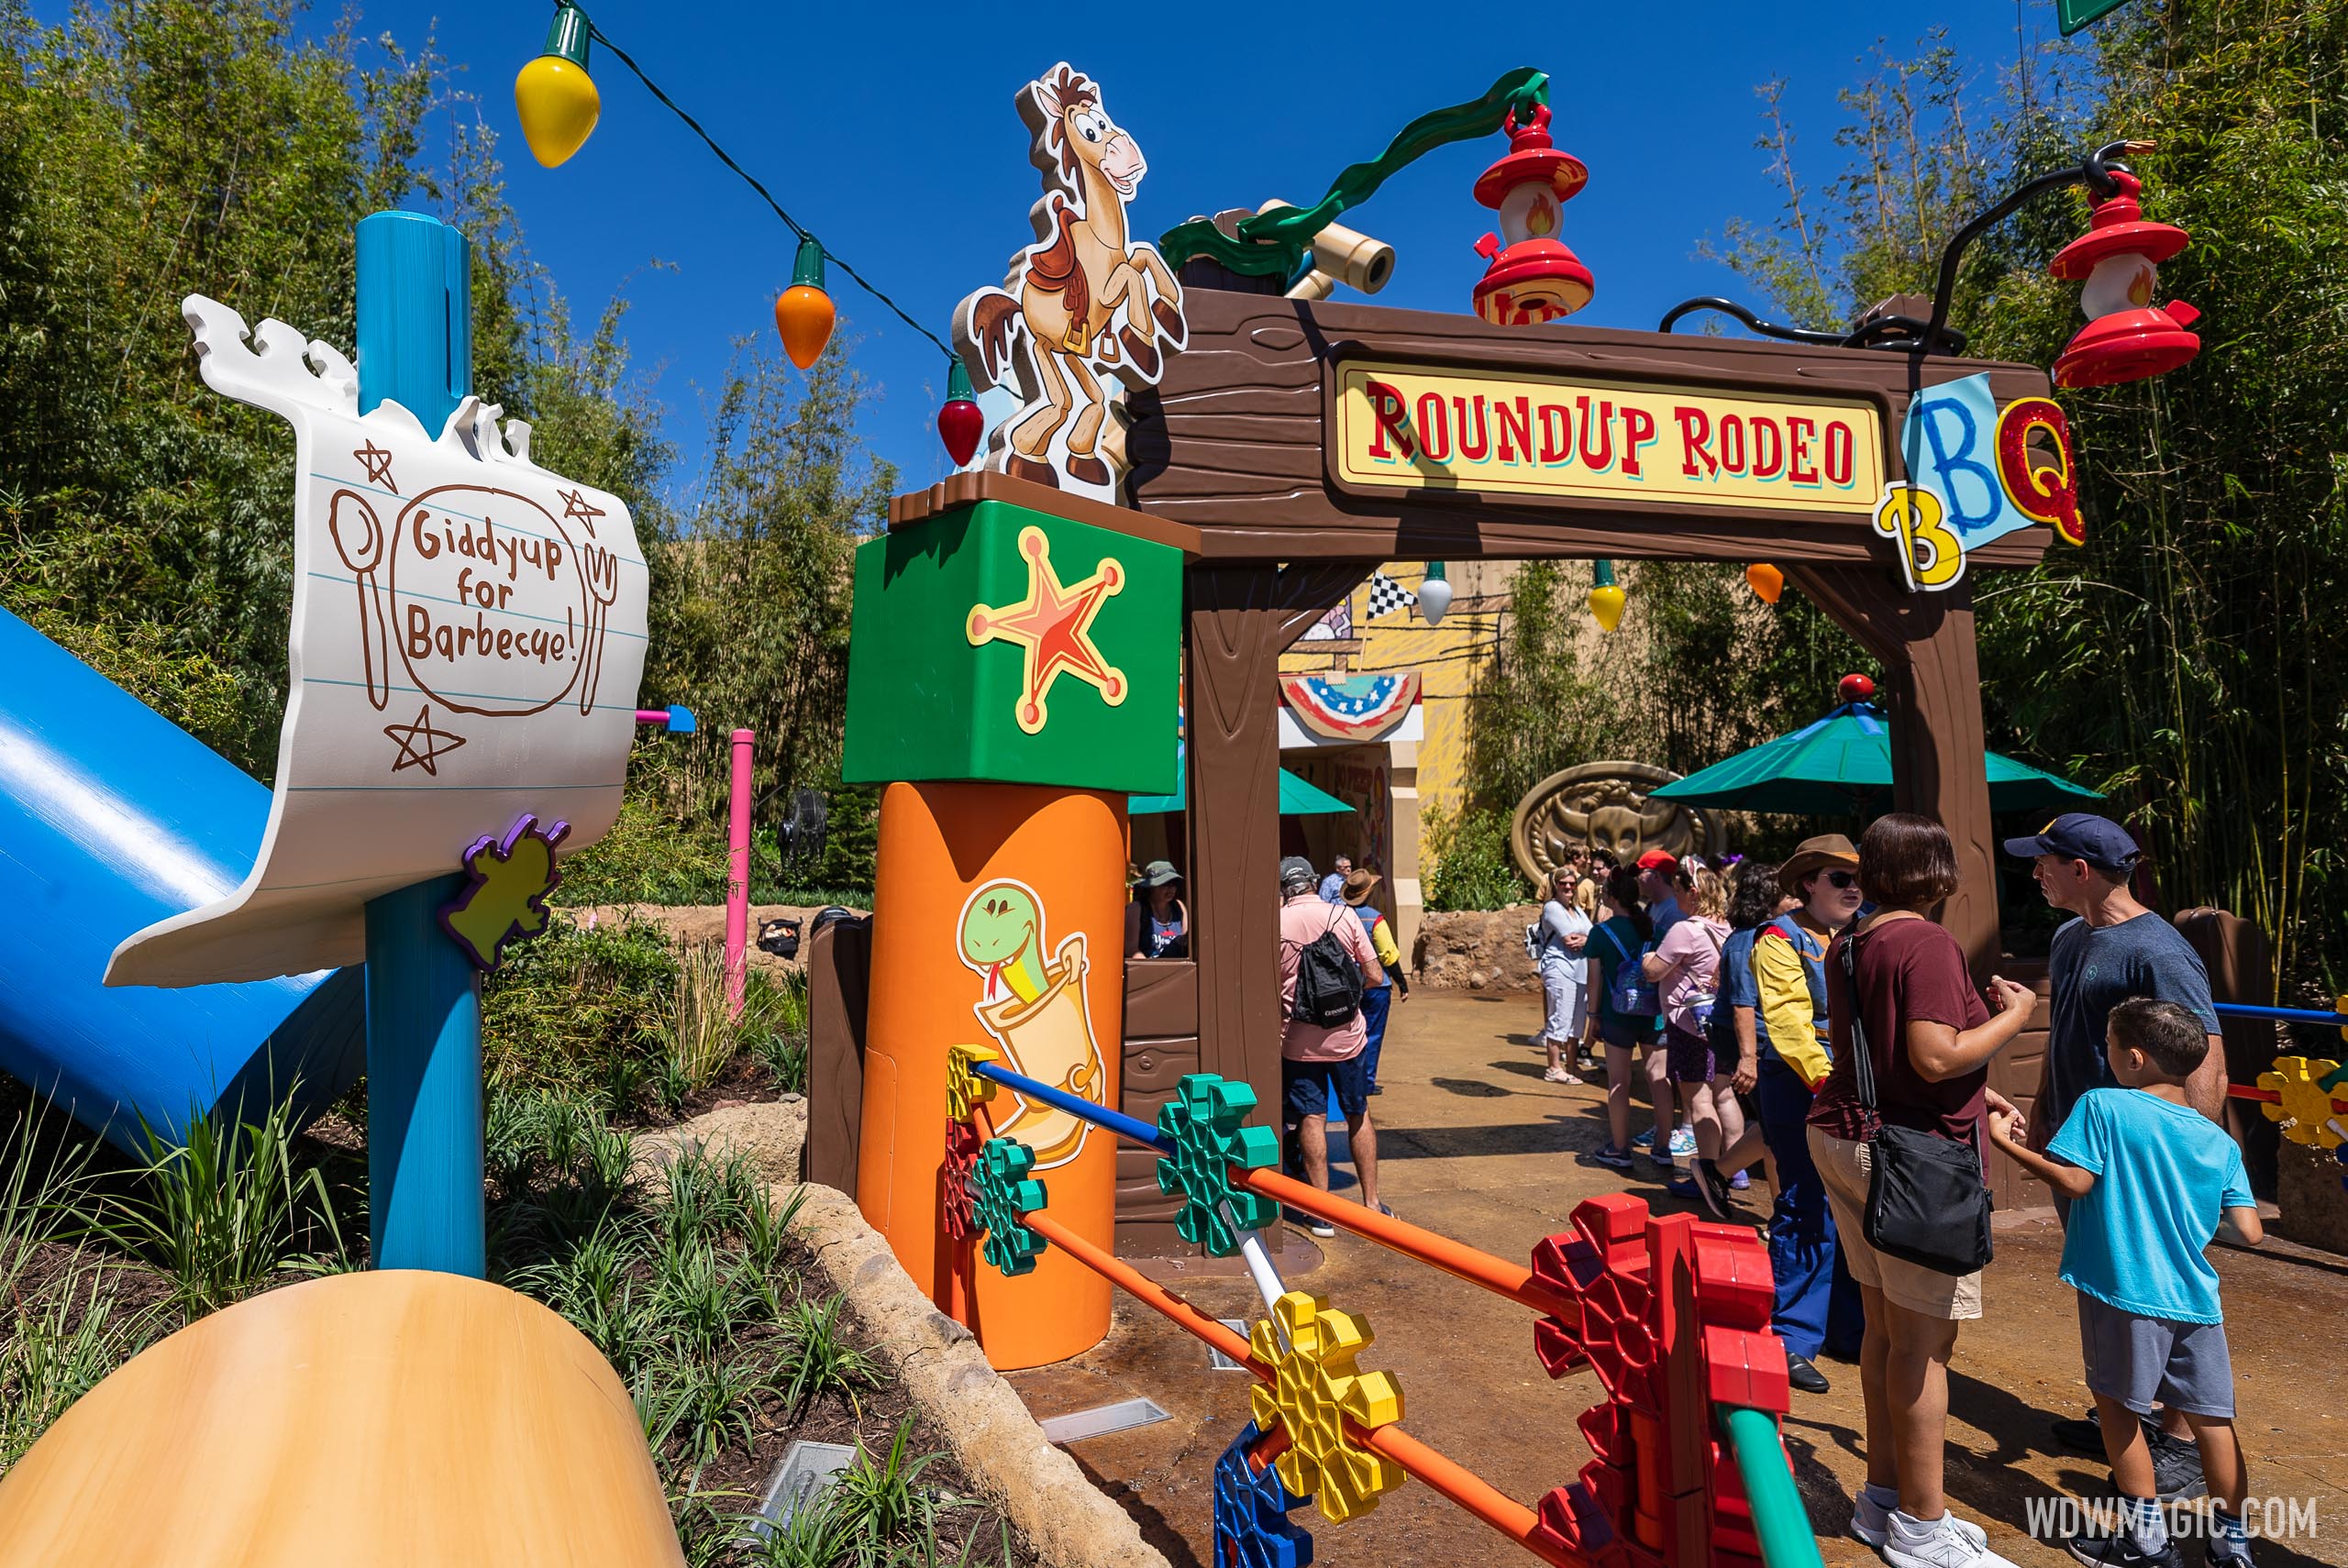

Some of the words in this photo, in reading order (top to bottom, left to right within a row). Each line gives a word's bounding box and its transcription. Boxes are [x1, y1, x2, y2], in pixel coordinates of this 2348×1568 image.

[1366, 380, 1656, 480] ROUNDUP
[1674, 405, 1855, 490] RODEO
[413, 509, 563, 580] Giddyup
[457, 567, 514, 610] for
[407, 603, 578, 664] Barbecue!
